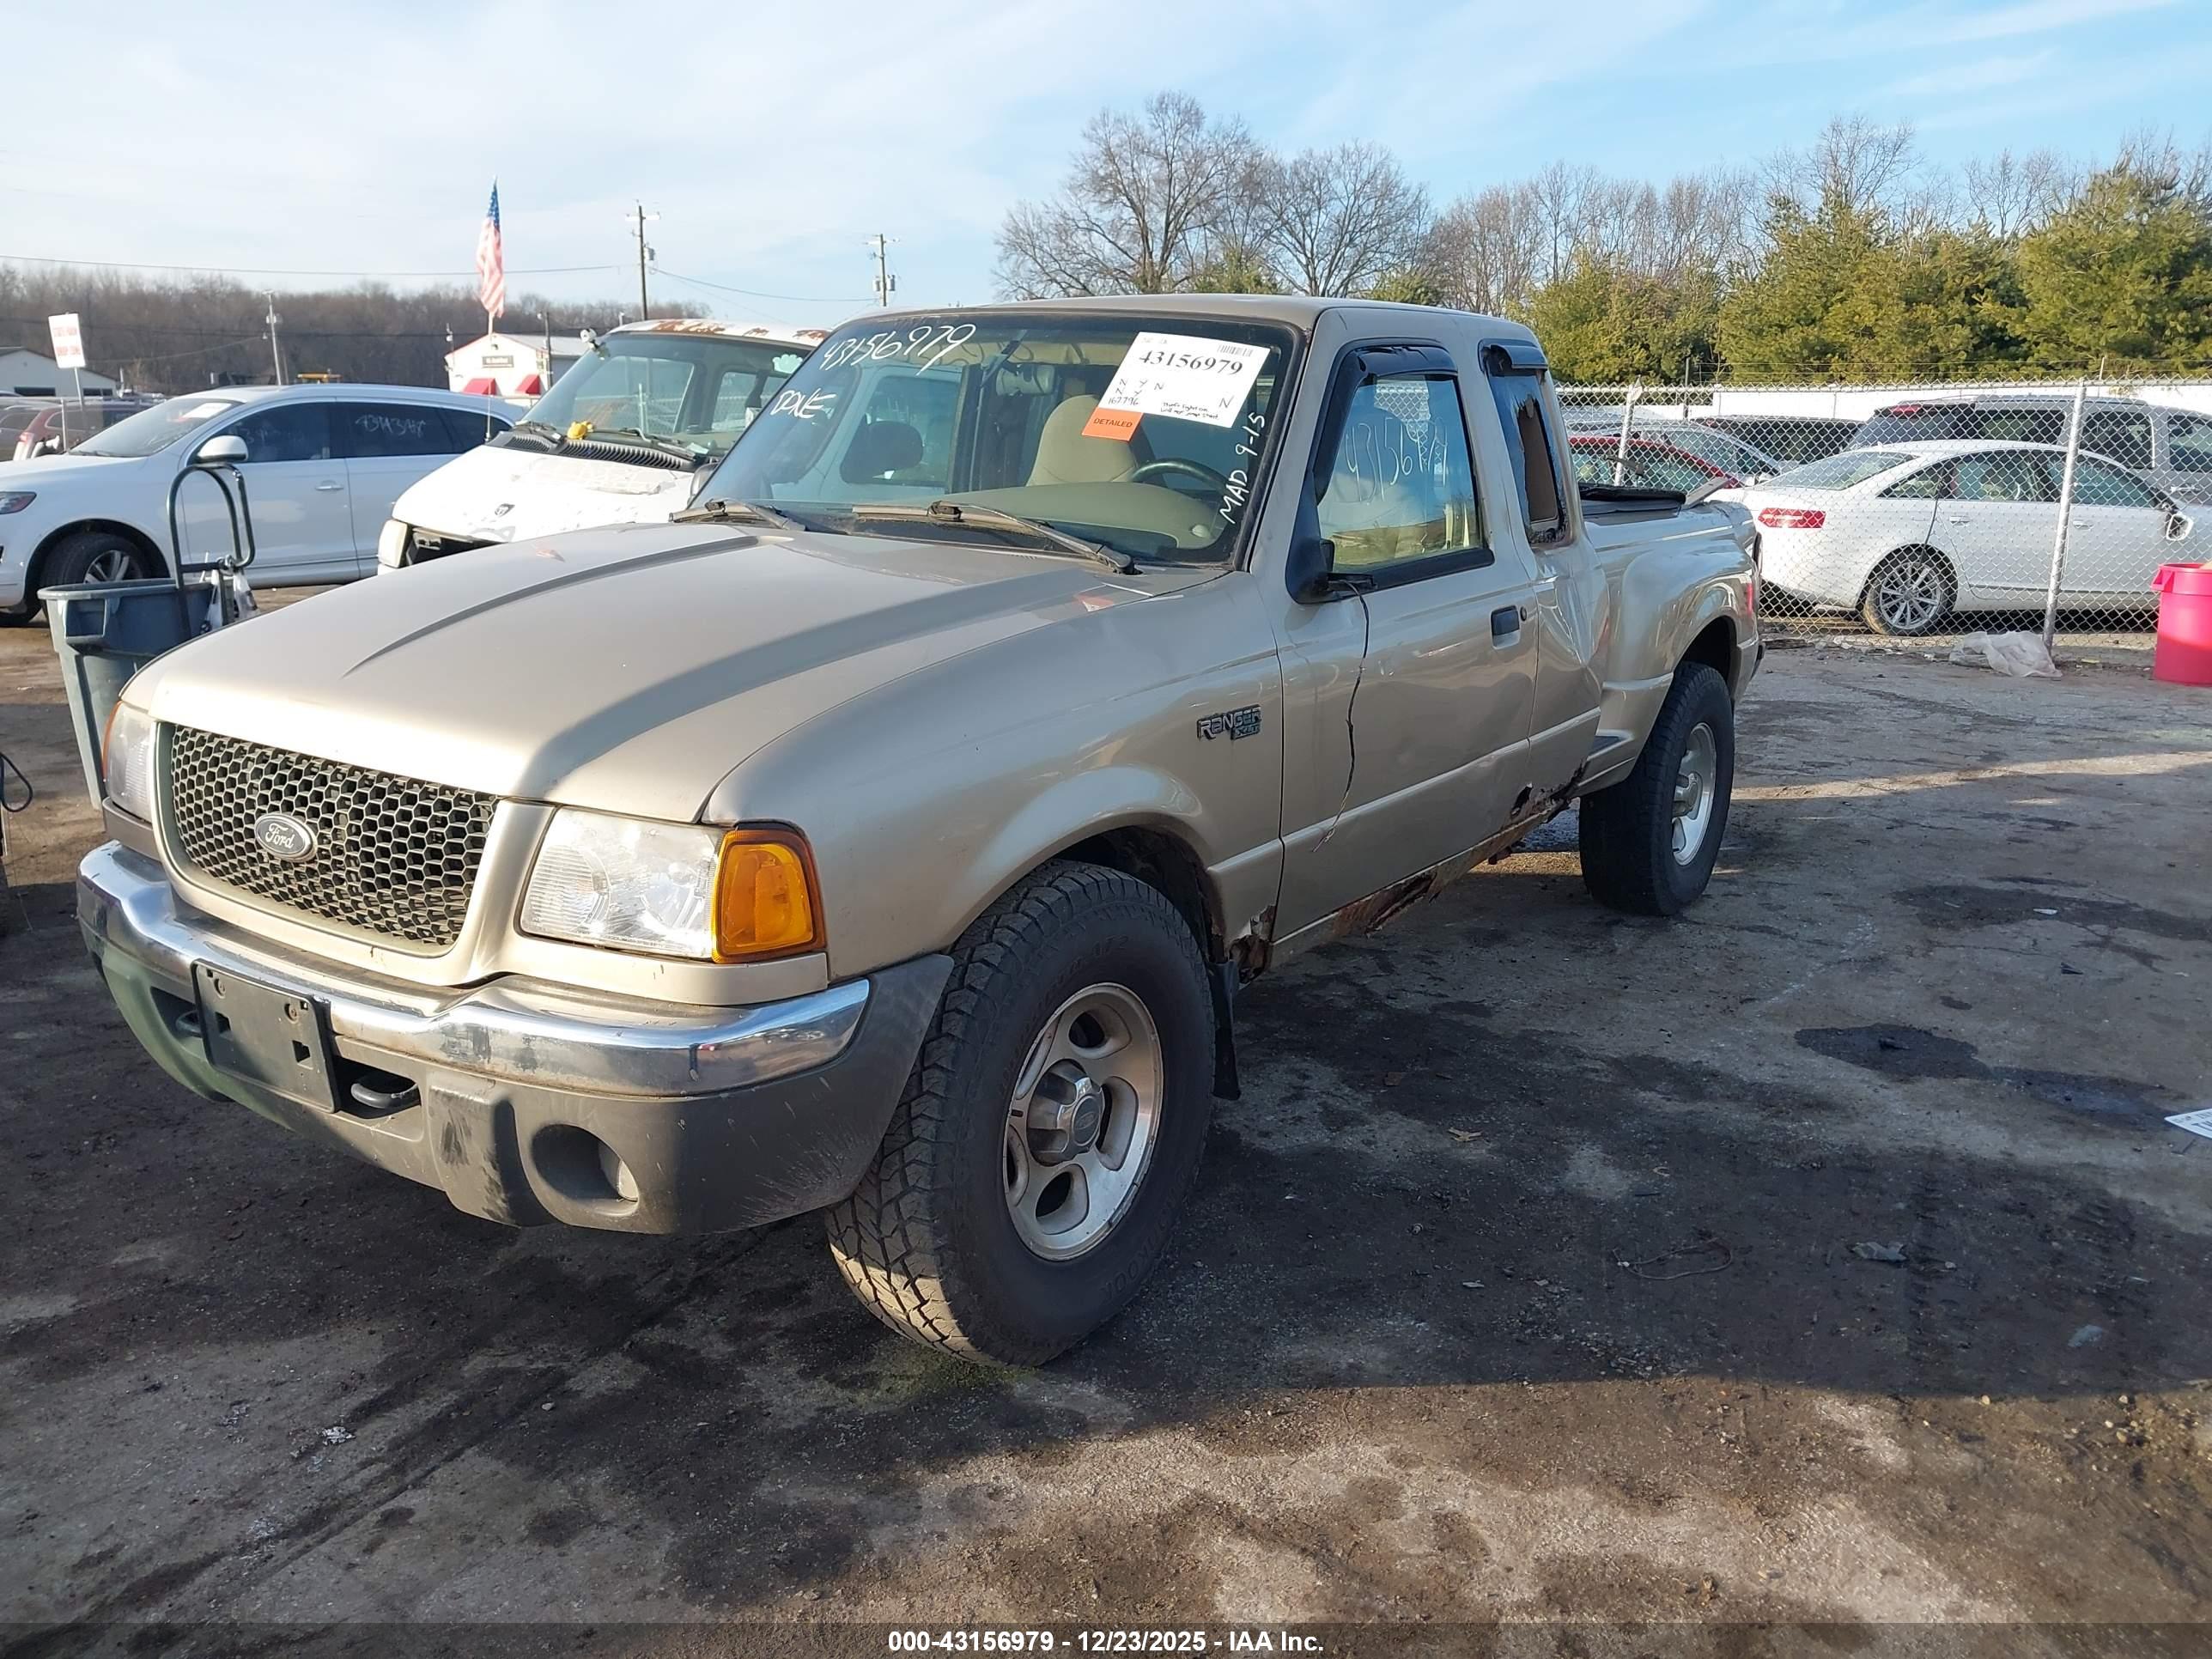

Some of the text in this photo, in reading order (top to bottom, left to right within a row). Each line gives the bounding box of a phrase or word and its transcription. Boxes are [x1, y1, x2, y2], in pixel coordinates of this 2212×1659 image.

[820, 324, 976, 376] 43156979
[1139, 350, 1243, 375] 43156979
[1093, 417, 1133, 428] DETAILED
[1219, 412, 1265, 524] MAD 9-15
[1198, 706, 1262, 739] RANGER
[265, 823, 295, 848] Ford
